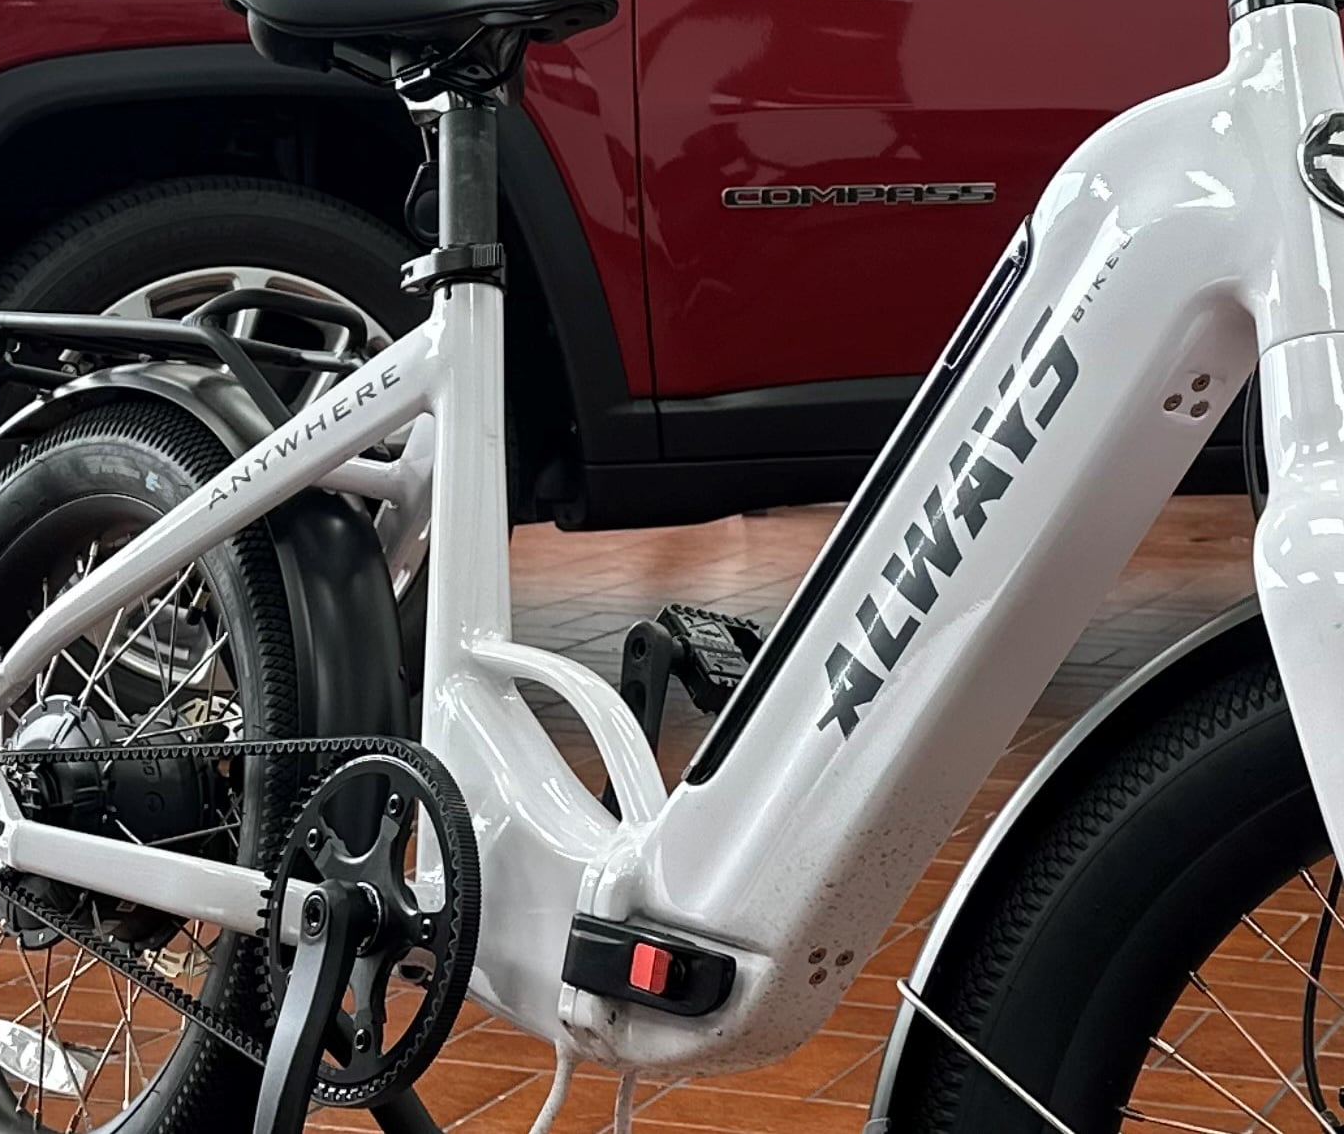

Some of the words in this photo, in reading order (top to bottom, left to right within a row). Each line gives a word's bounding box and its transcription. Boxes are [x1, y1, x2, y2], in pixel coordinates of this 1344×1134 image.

[721, 182, 997, 208] COMPASS
[209, 364, 401, 510] ANYWHERE
[816, 304, 1080, 742] ALWAYS
